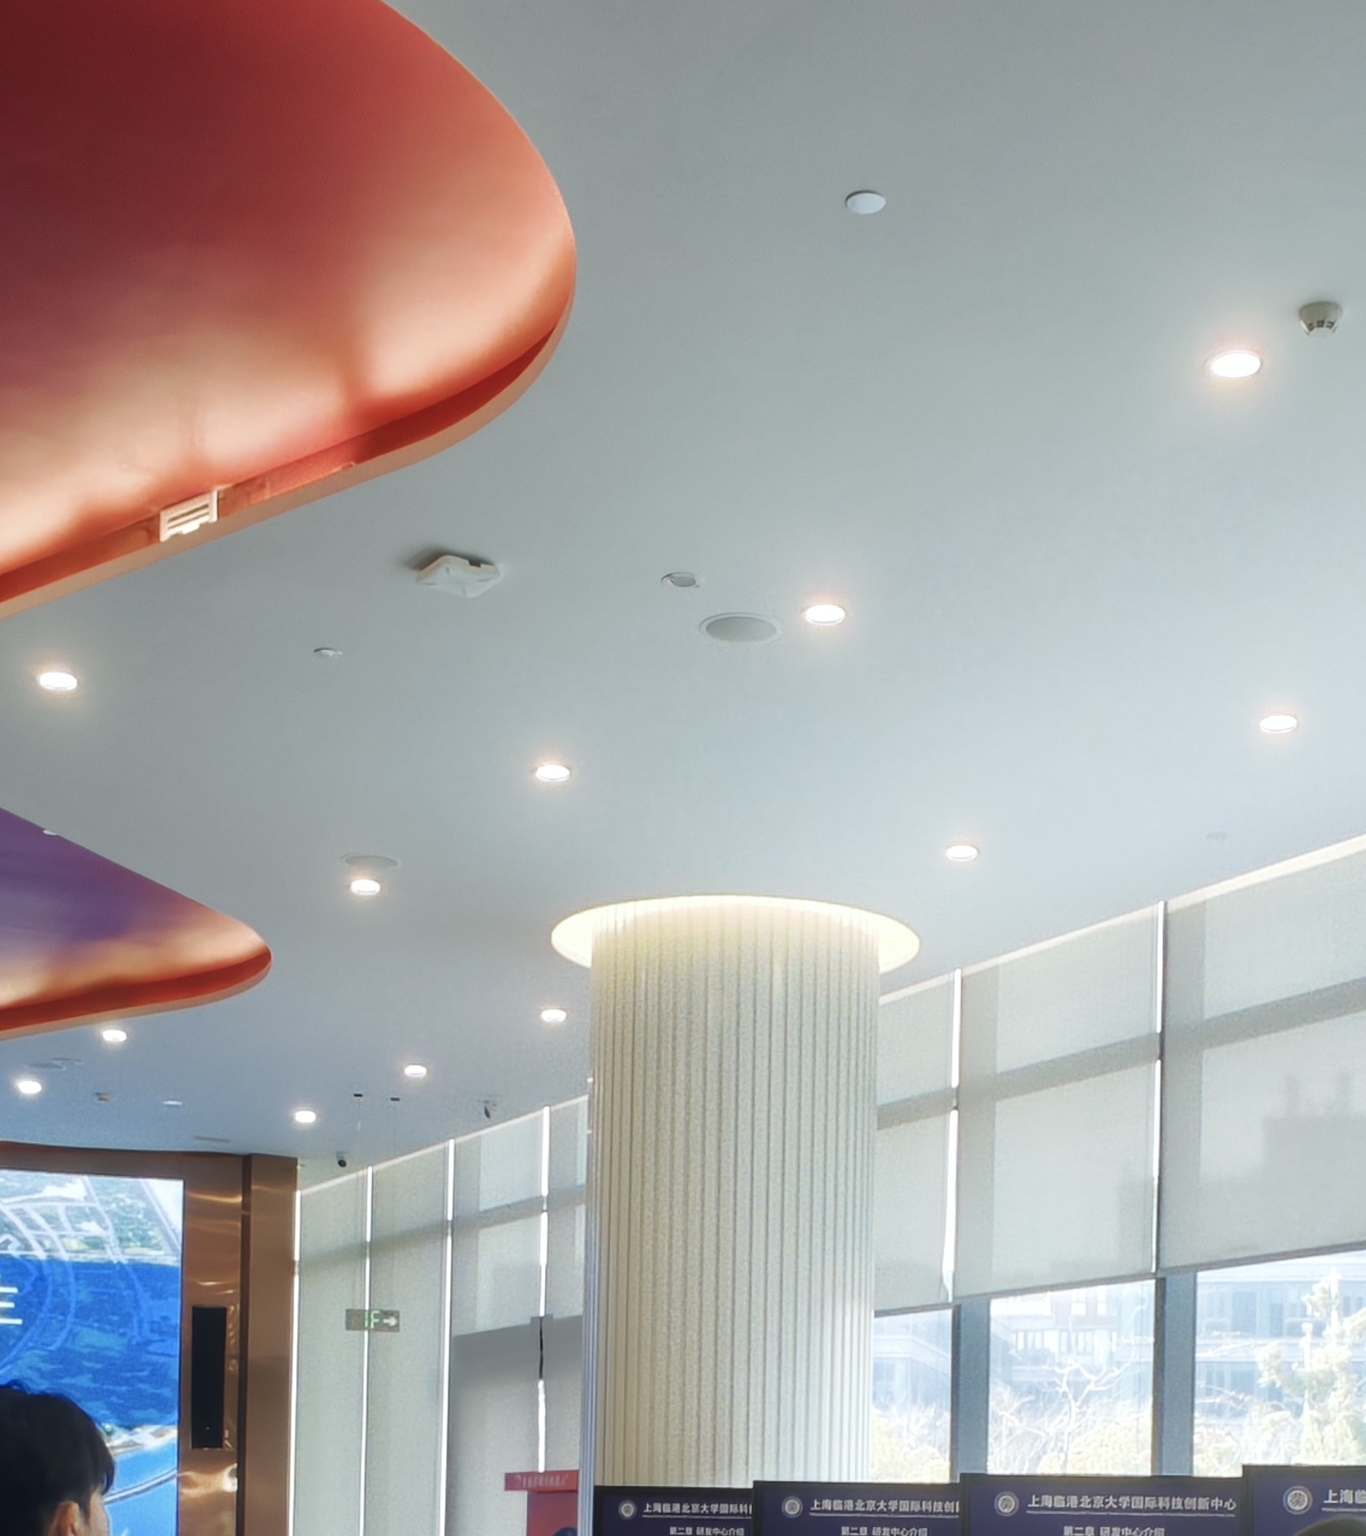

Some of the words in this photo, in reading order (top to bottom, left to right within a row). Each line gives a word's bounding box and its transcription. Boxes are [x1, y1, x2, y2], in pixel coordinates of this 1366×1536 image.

[810, 1499, 960, 1514] 上海临港北京大学国际科技创
[1028, 1494, 1237, 1511] 上海临港北京大学国际科技创新中心
